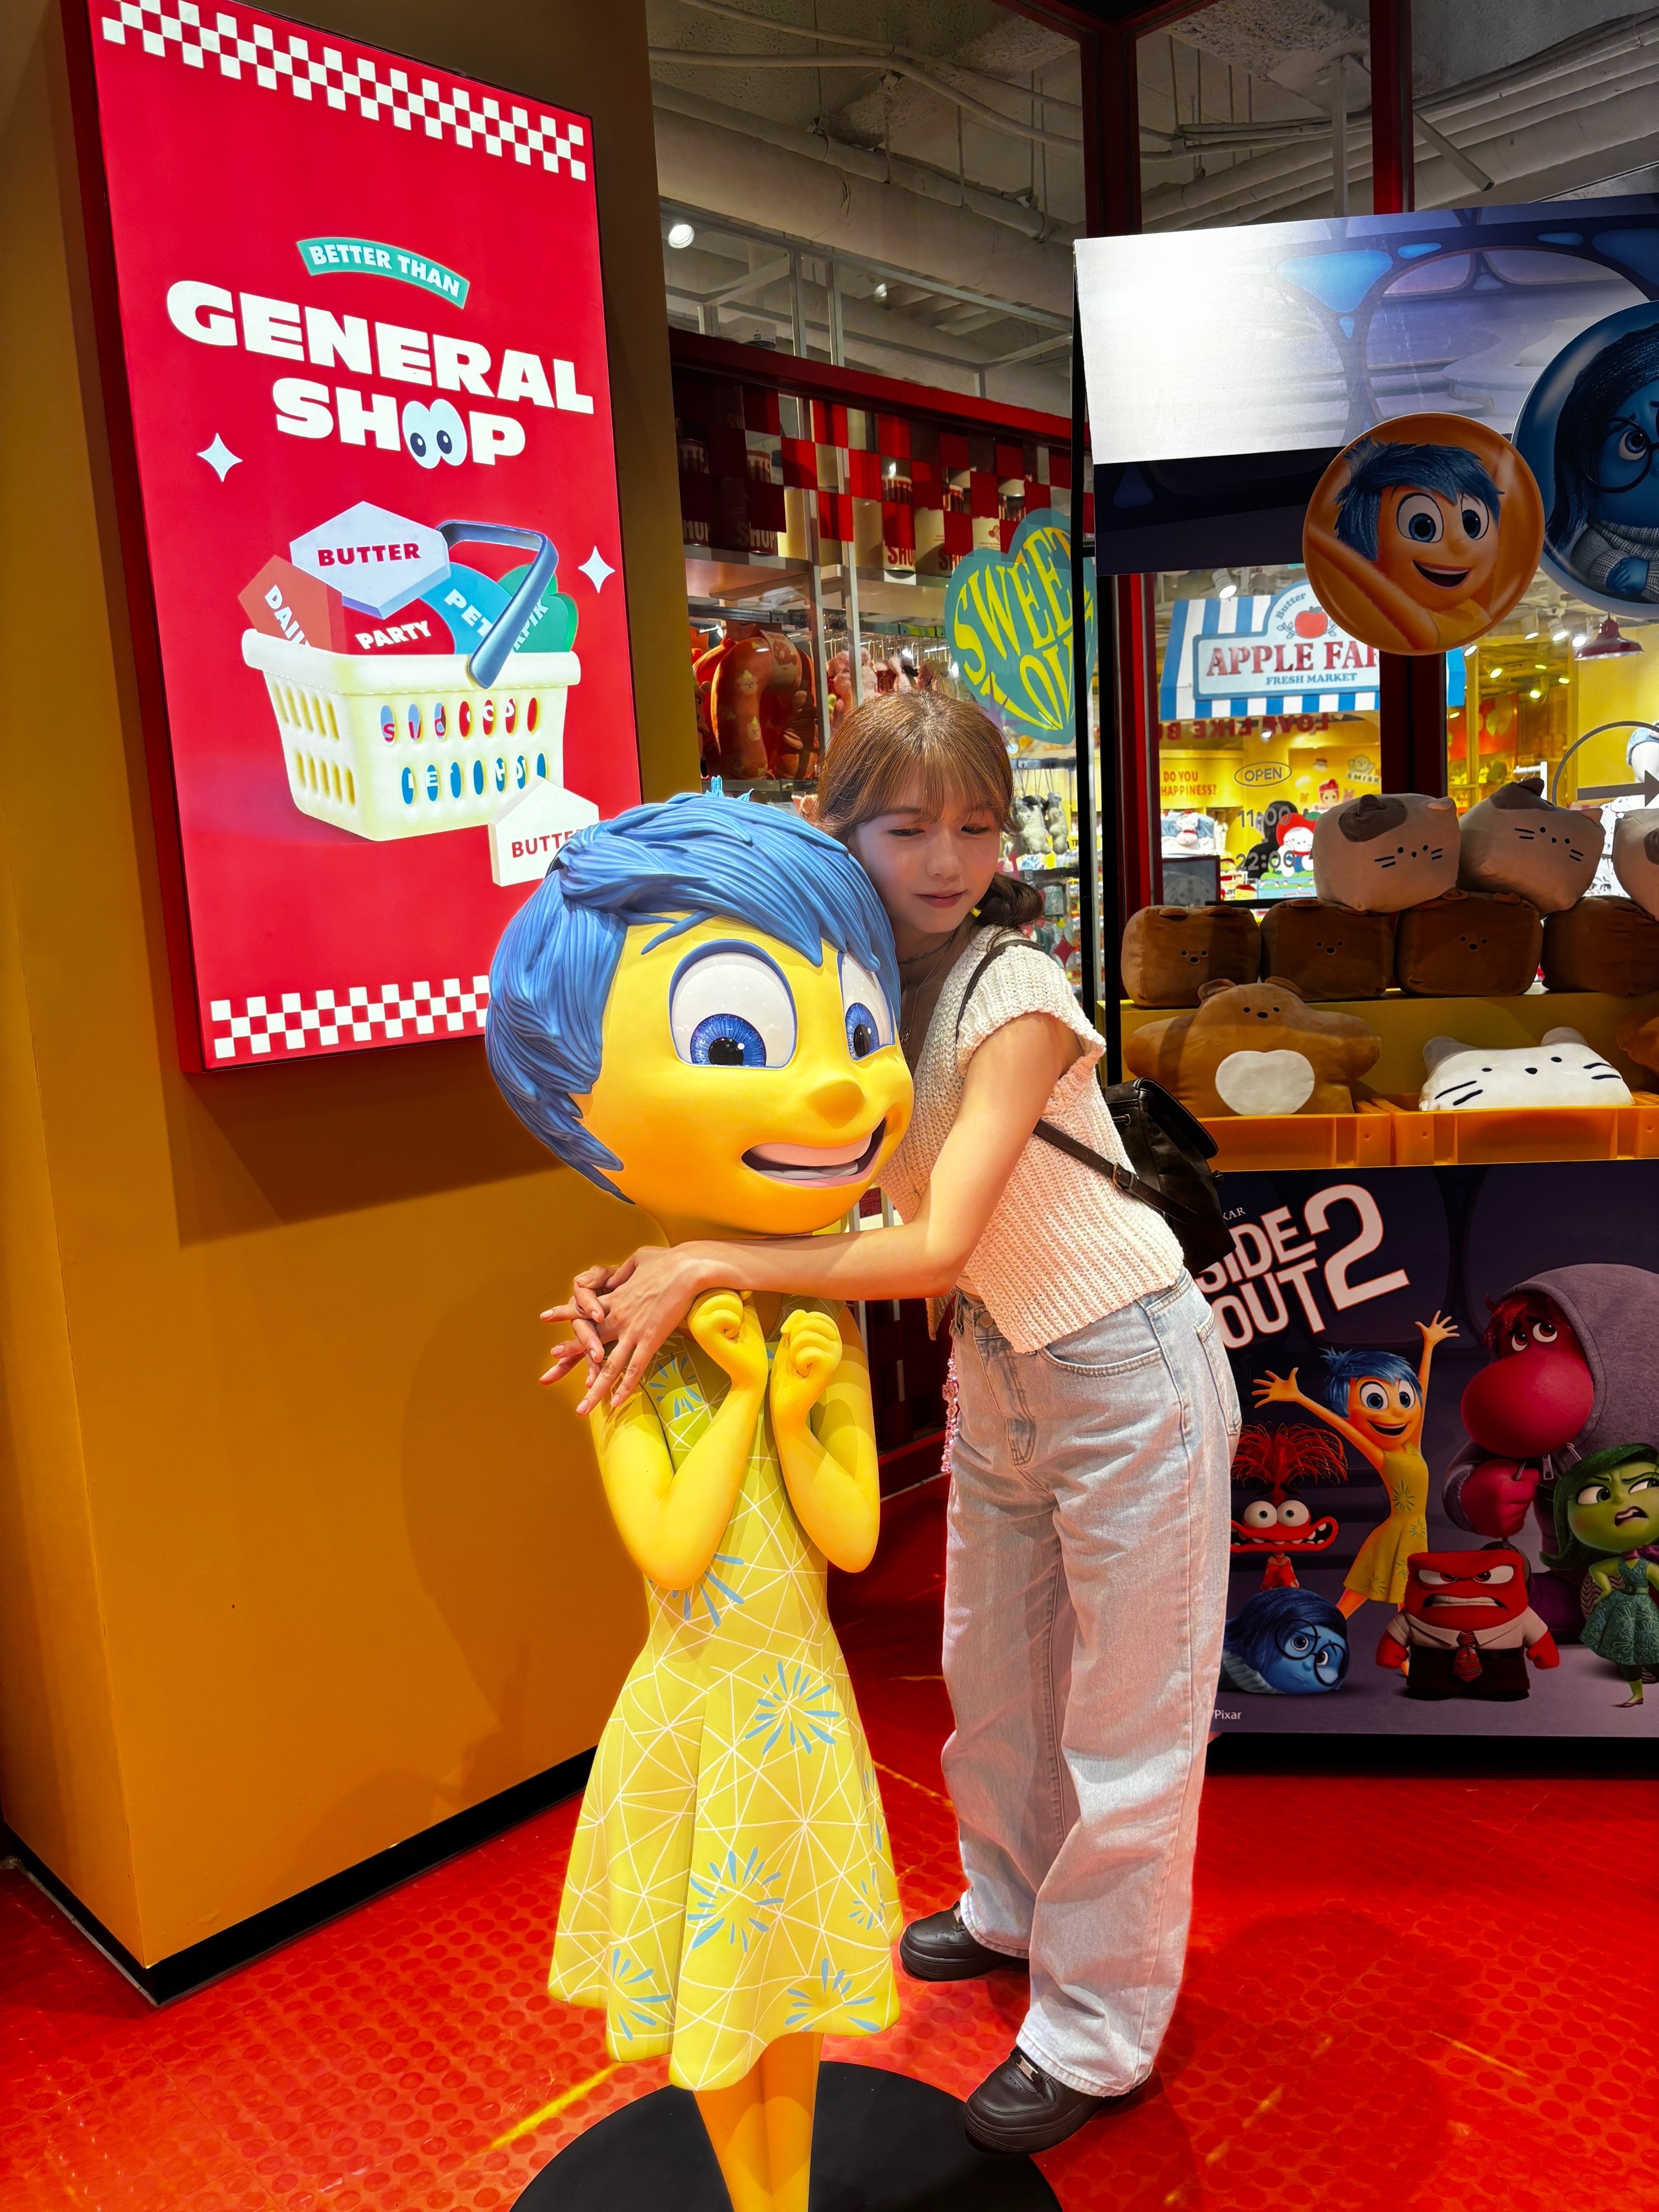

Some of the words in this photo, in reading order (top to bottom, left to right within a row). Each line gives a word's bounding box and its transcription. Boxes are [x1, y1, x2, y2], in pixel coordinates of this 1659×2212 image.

[308, 244, 393, 269] BETTER
[397, 254, 460, 298] THAN
[166, 280, 594, 414] GENERAL
[317, 543, 421, 567] BUTTER
[265, 584, 311, 648] DAIL
[1275, 592, 1306, 621] Butter
[355, 621, 431, 650] PARTY
[1206, 643, 1314, 676] APPLE
[980, 632, 1093, 730] LOV
[1266, 676, 1304, 686] FRESH
[1307, 672, 1358, 684] MARKET
[1163, 771, 1176, 782] DO
[1178, 771, 1198, 781] YOU
[1244, 767, 1283, 782] OPEN
[1161, 784, 1217, 796] HAPPINESS?
[1237, 805, 1291, 828] 11:00
[511, 829, 582, 858] BUTT
[1236, 850, 1296, 872] 22:00
[1303, 1184, 1411, 1311] 2
[1209, 1258, 1326, 1349] OUT
[1215, 1709, 1242, 1719] Pixar
